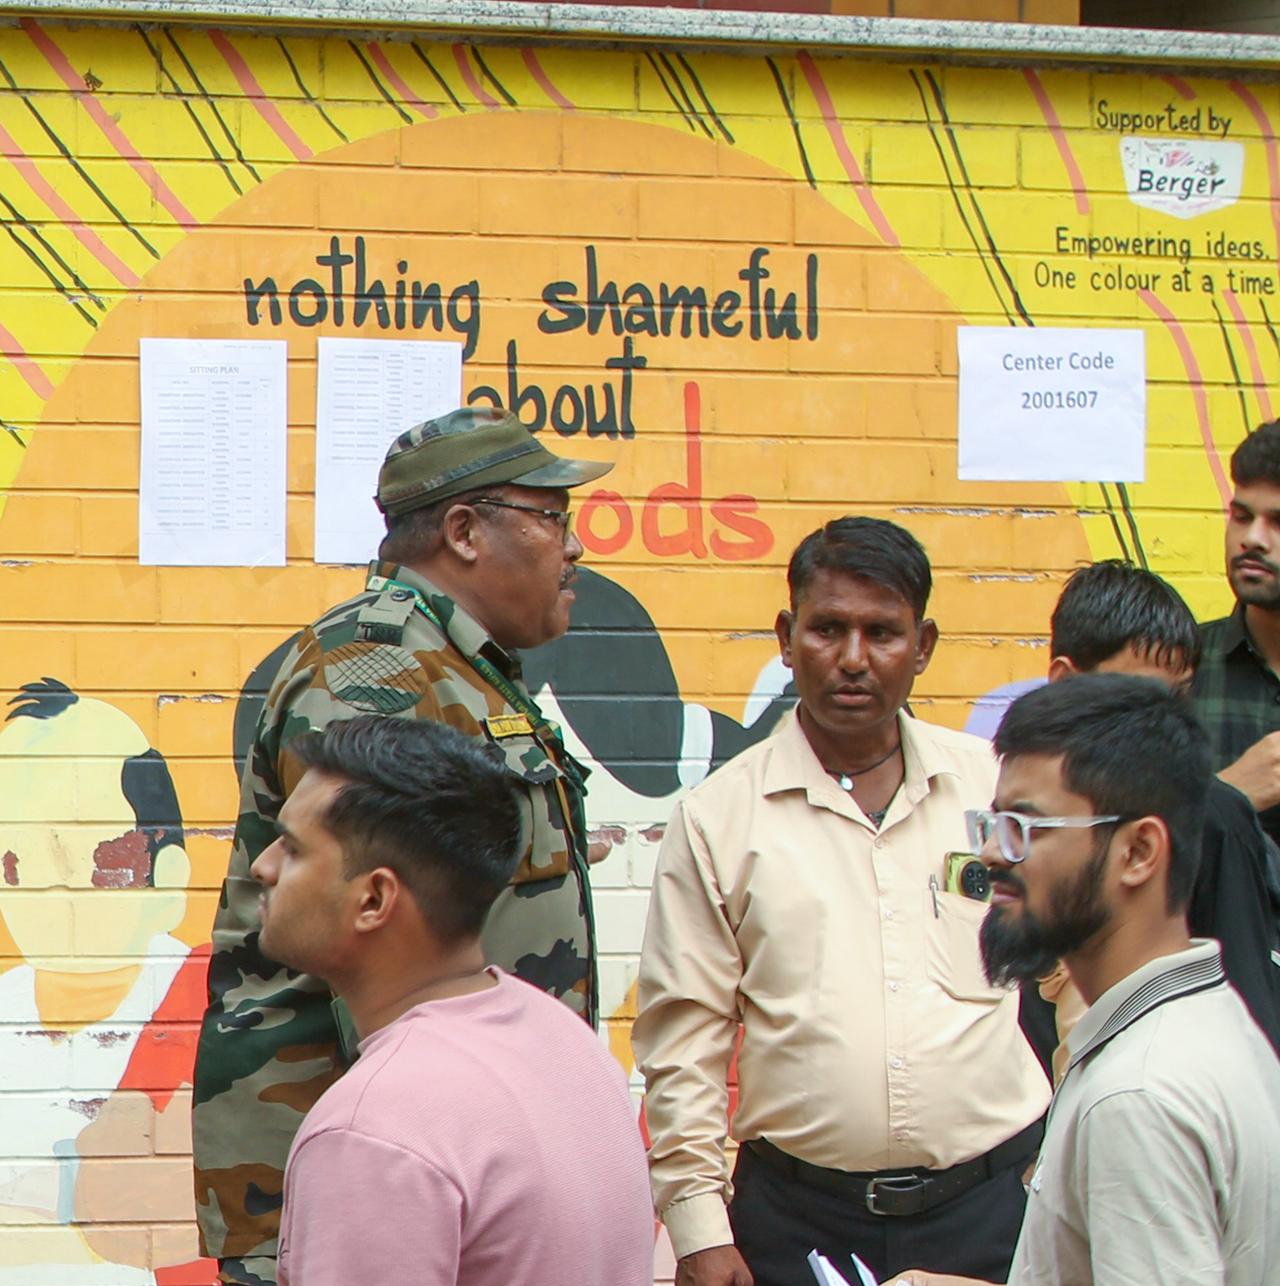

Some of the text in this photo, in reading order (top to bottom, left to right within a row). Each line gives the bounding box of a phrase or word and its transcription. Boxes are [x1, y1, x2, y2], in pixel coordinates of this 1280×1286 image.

[1096, 100, 1231, 138] Supported by
[1137, 168, 1226, 201] Berger
[1055, 226, 1192, 264] Empowering
[1034, 261, 1276, 296] One colour at a time
[243, 235, 820, 360] nothing shameful
[189, 366, 240, 375] SITTING PLAN
[1002, 352, 1115, 372] Center Code
[466, 335, 648, 440] about
[1020, 390, 1099, 410] 2001607
